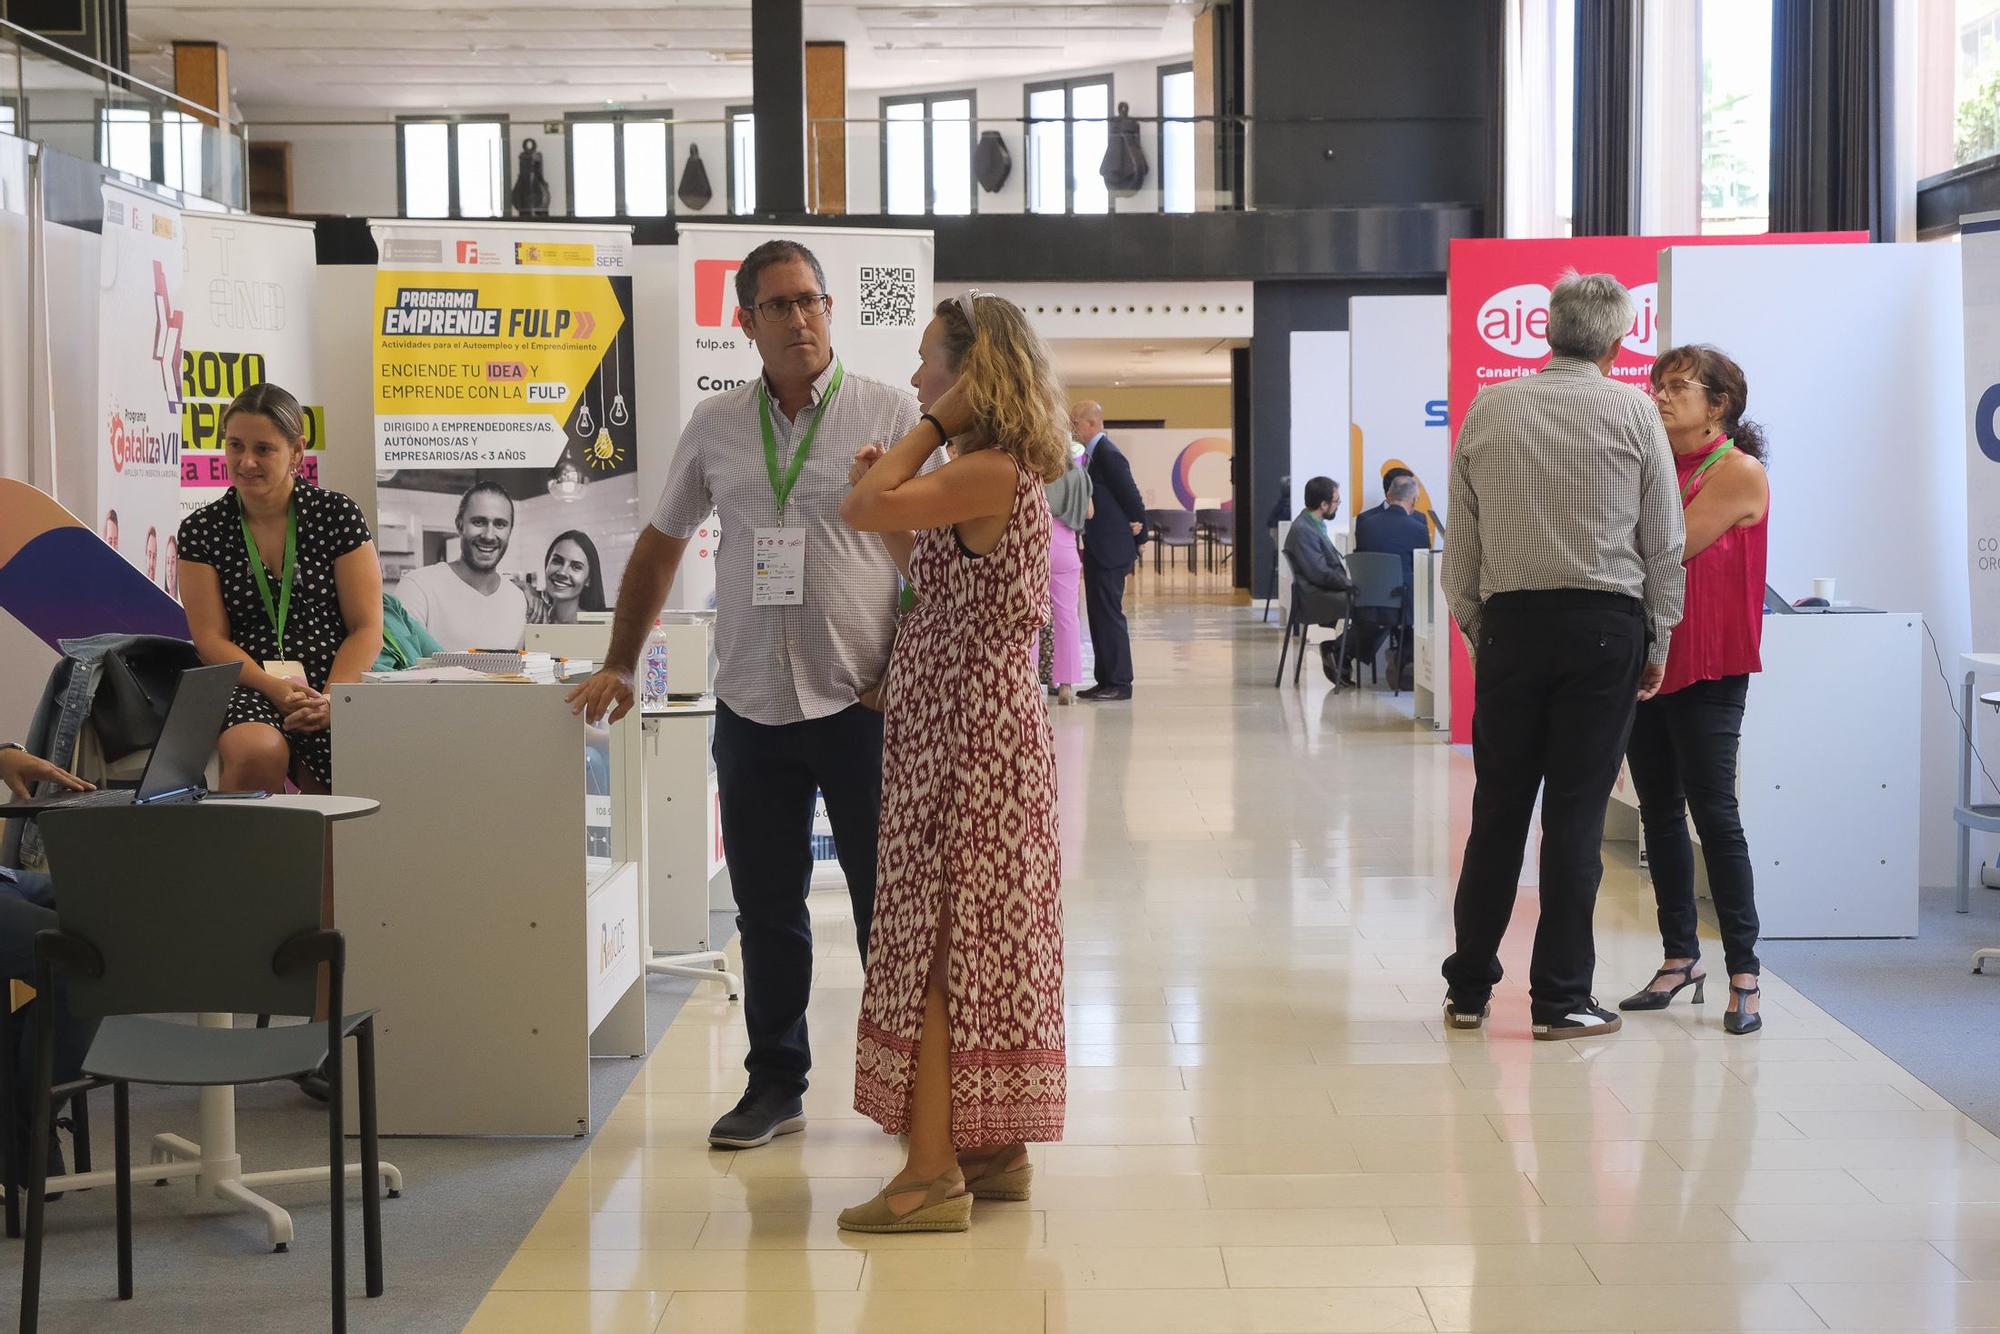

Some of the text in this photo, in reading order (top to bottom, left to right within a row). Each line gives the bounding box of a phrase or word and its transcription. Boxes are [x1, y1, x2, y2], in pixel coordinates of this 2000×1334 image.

[596, 256, 623, 267] SEPE
[400, 291, 474, 308] PROGRAMA
[385, 309, 571, 338] EMPRENDE FULP
[1483, 299, 1549, 345] aje
[382, 340, 431, 349] Actividades
[433, 342, 452, 351] para
[453, 341, 461, 349] el
[463, 341, 513, 351] Autoempleo
[522, 342, 529, 350] el
[531, 342, 597, 352] Emprendimiento
[696, 338, 735, 350] fulp.es
[382, 363, 539, 378] ENCIENDE TU IDEA Y
[1477, 366, 1537, 378] Canarias
[382, 385, 566, 400] EMPRENDE CON LA FULP
[384, 422, 554, 433] DIRIGIDO A EMPRENDEDORES/AS,
[384, 435, 478, 447] AUTÓNOMOS/AS Y
[384, 451, 479, 462] EMPRESARIOS/AS
[488, 451, 495, 461] 3
[497, 449, 526, 461] AÑOS
